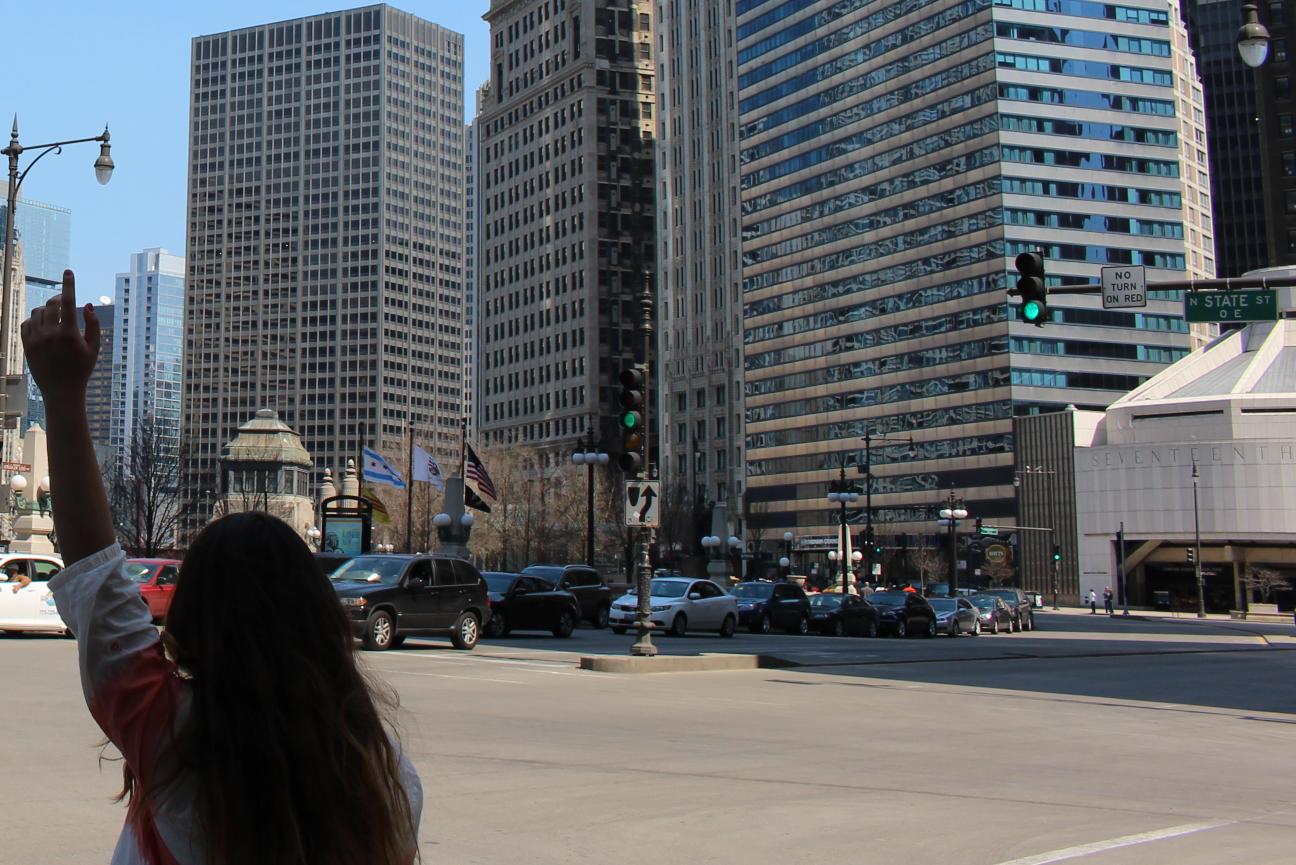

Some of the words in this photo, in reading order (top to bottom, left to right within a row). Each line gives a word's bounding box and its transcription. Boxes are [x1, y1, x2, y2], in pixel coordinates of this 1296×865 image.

[1115, 271, 1131, 280] NO
[1111, 283, 1137, 291] TURN
[1106, 295, 1119, 303] ON
[1124, 293, 1143, 303] RED
[1189, 297, 1198, 306] N
[1204, 294, 1248, 307] STATE
[1255, 295, 1271, 304] ST
[1234, 310, 1242, 318] E
[1090, 445, 1293, 467] SEVENTEENTH
